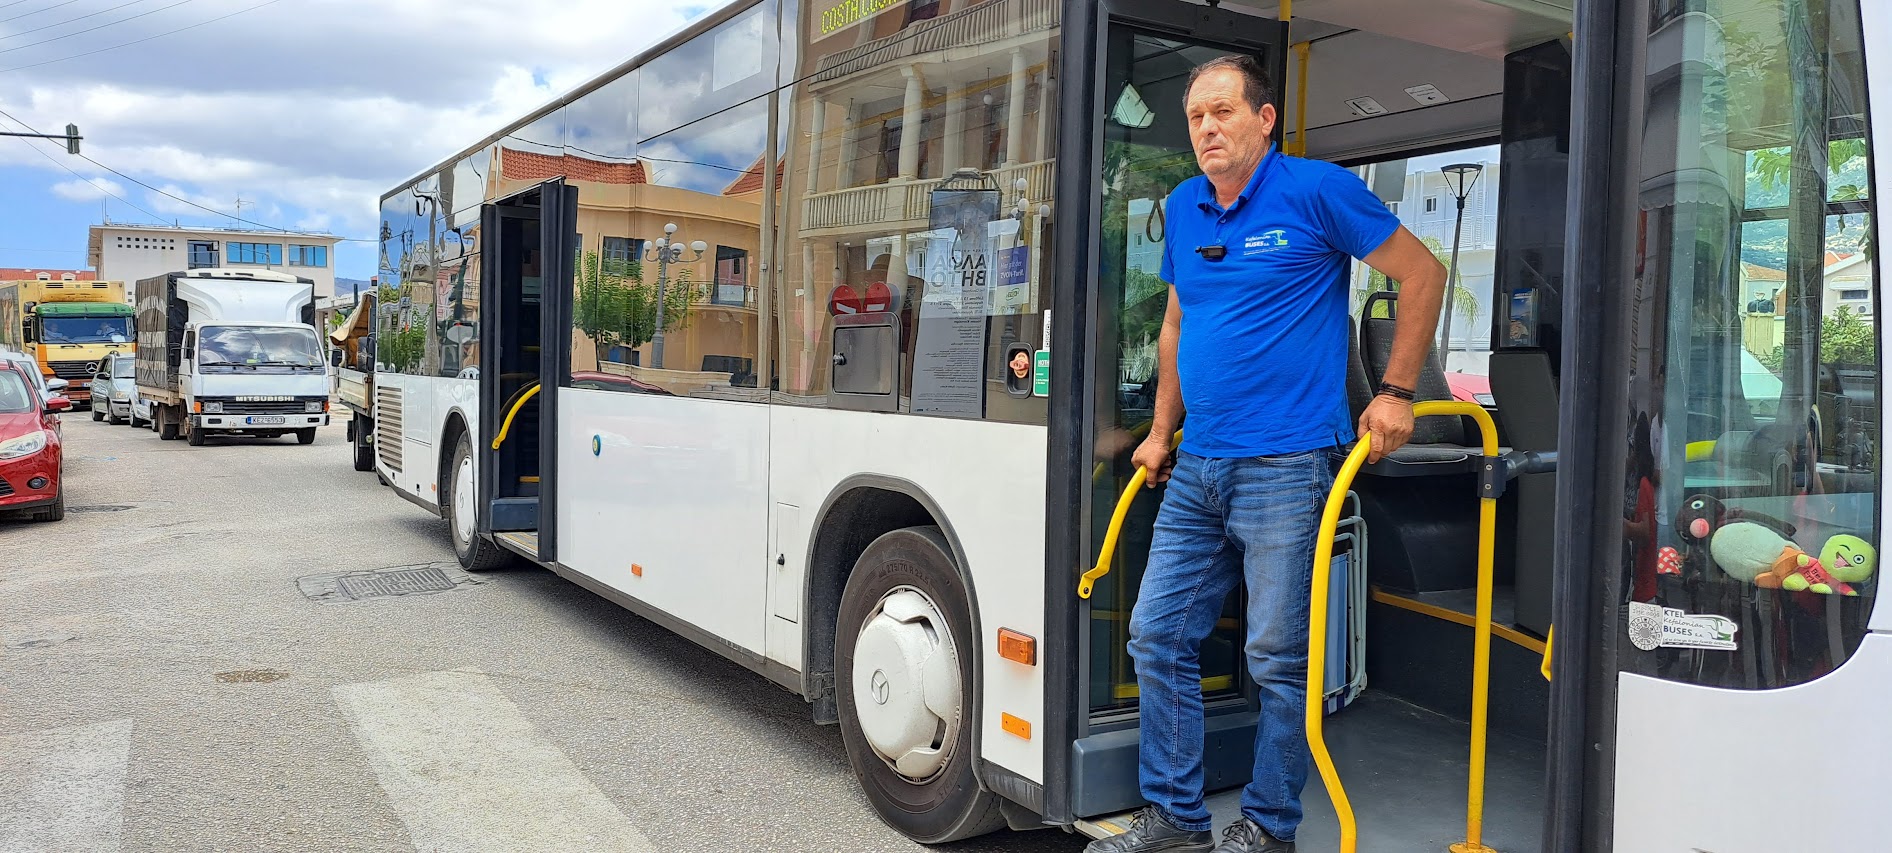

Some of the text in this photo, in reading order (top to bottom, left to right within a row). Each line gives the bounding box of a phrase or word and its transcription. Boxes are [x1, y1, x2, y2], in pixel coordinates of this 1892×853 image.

[886, 563, 908, 574] 275/70
[909, 565, 914, 574] R
[1664, 609, 1684, 618] KTEL
[1663, 617, 1705, 628] Kefalonian
[1663, 625, 1693, 636] BUSES
